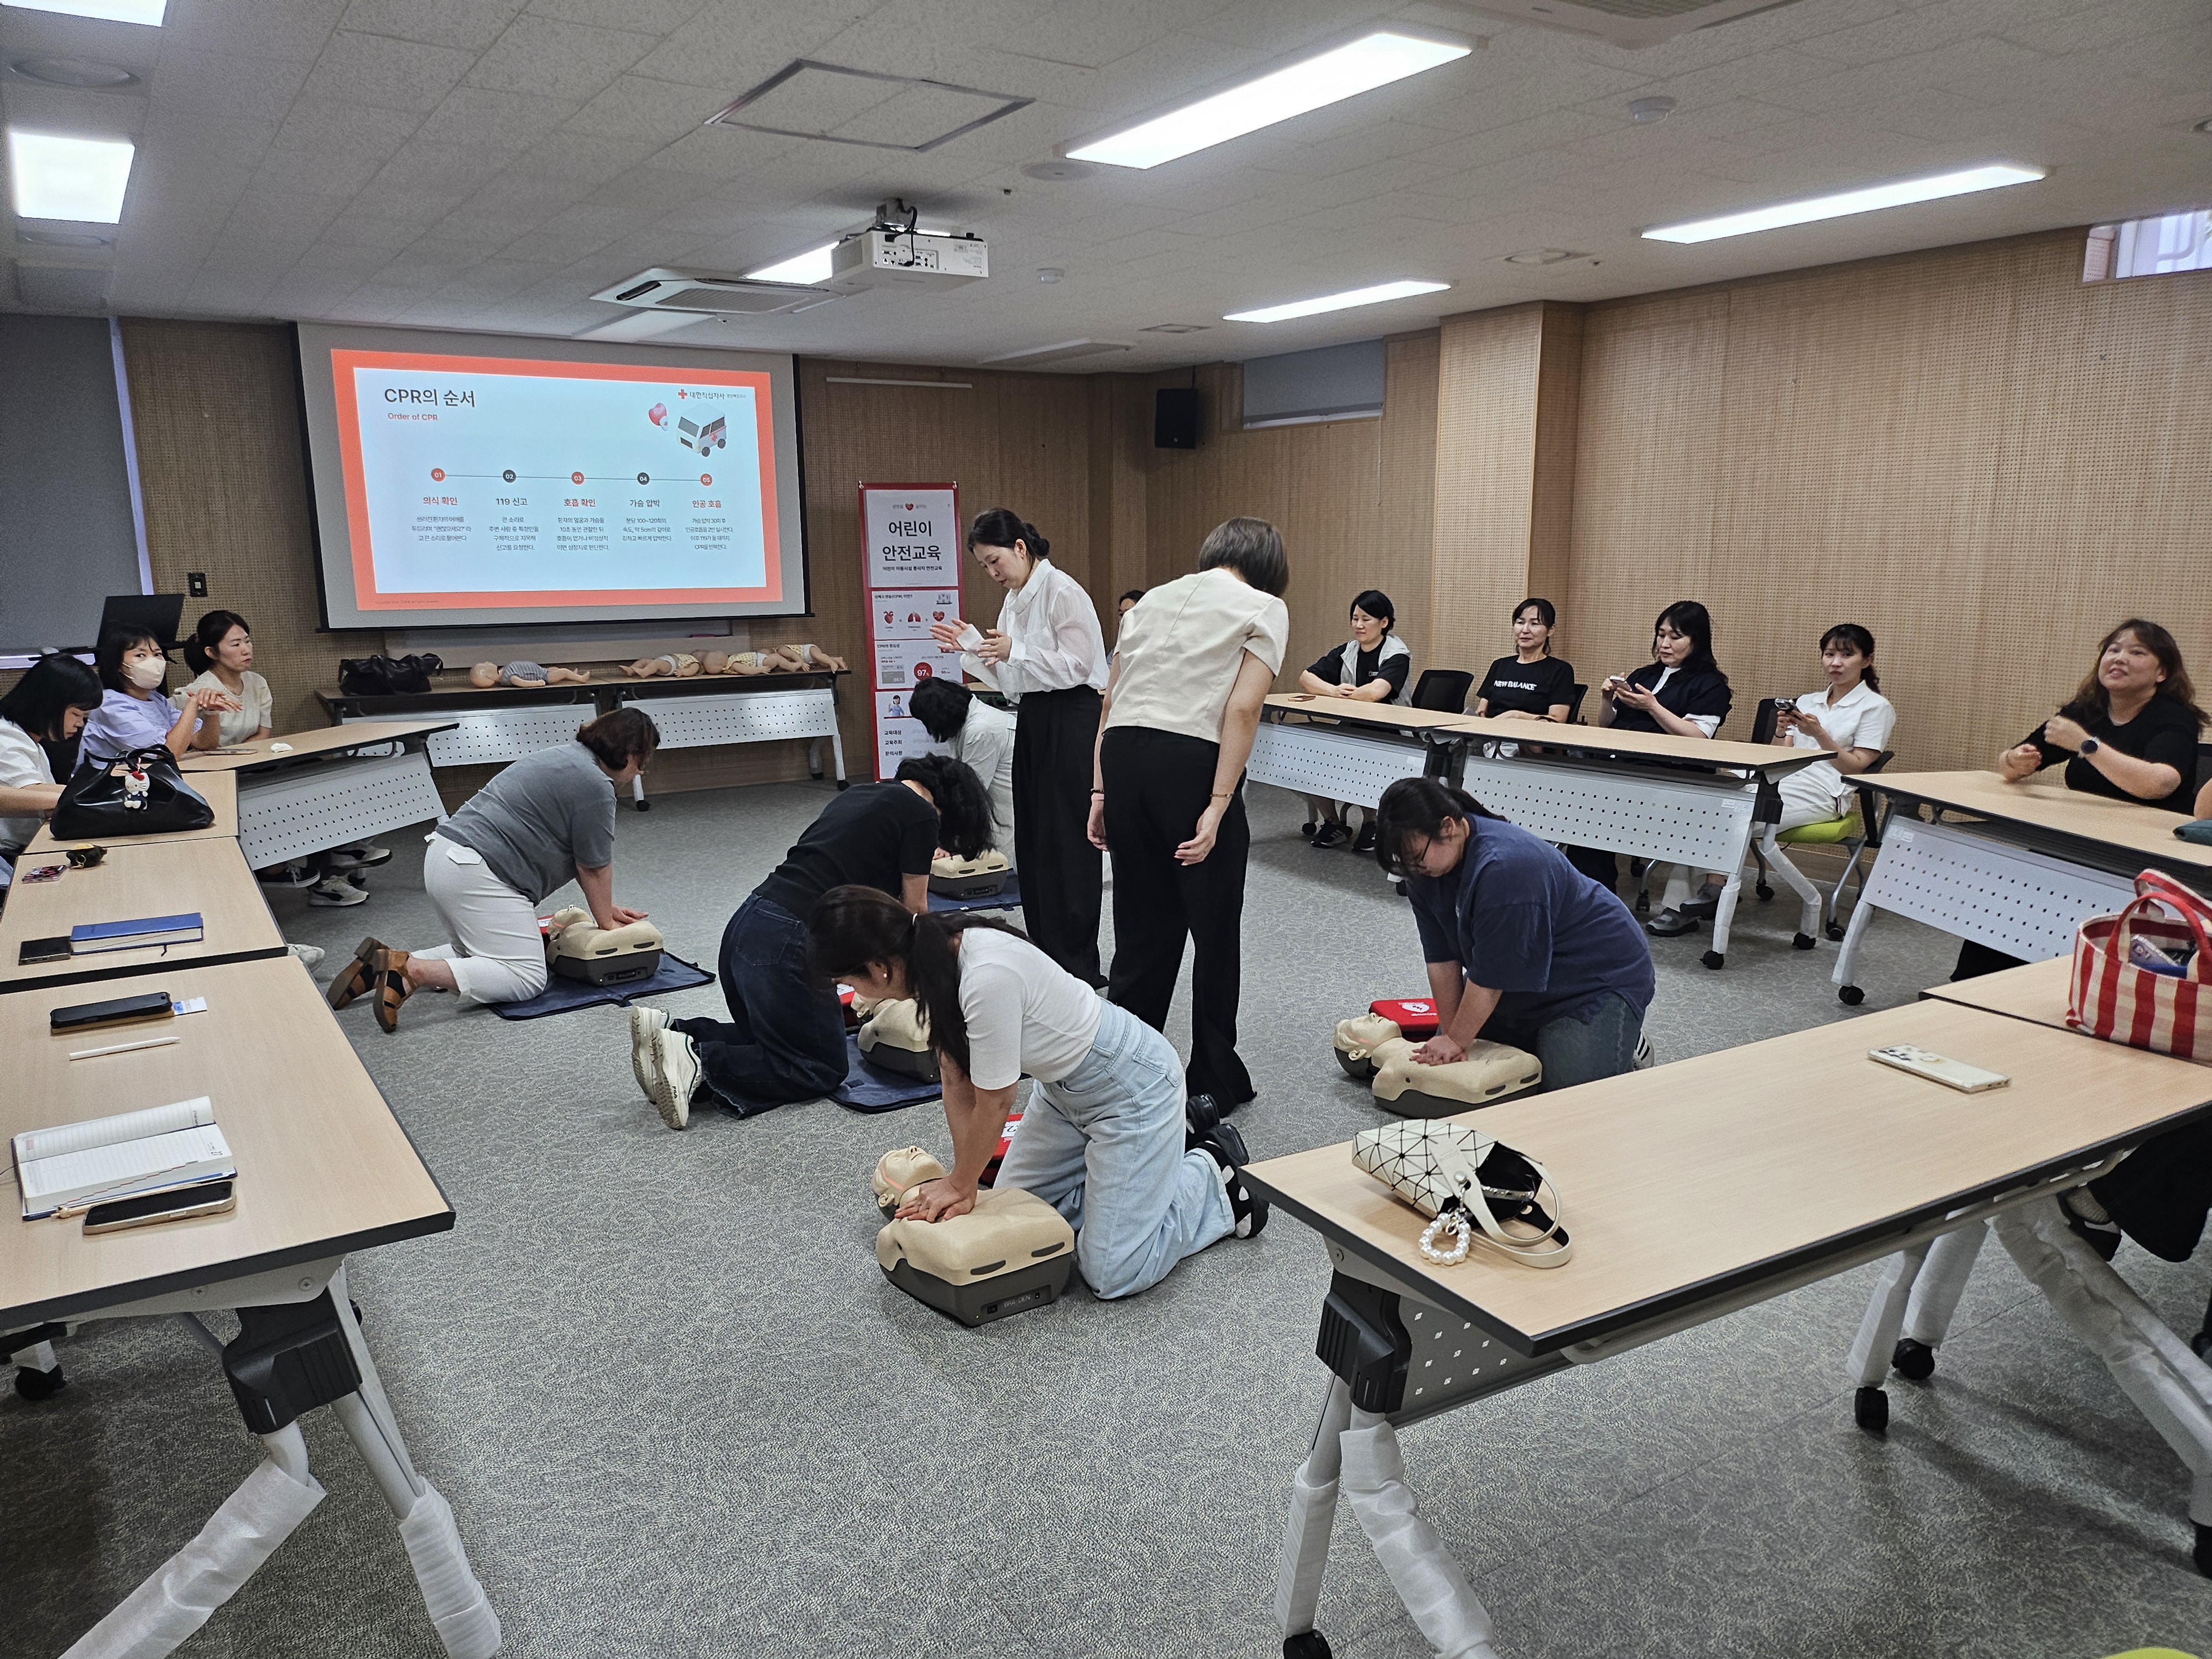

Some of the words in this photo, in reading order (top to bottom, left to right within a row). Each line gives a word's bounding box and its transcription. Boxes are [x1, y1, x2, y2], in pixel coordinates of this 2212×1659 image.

[384, 388, 438, 406] CPR의
[444, 390, 475, 408] 순서
[690, 392, 725, 400] 대한적십자사
[424, 497, 439, 505] 의식
[442, 497, 458, 505] 확인
[564, 499, 579, 507] 호흡
[581, 499, 596, 507] 확인
[630, 499, 644, 508] 가슴
[646, 499, 660, 508] 압박
[692, 500, 706, 508] 인공
[708, 500, 721, 508] 호흡
[889, 520, 932, 536] 어린이
[883, 545, 941, 561] 안전교육
[1507, 681, 1537, 691] BALANCE
[1004, 1295, 1030, 1307] BRADEN
